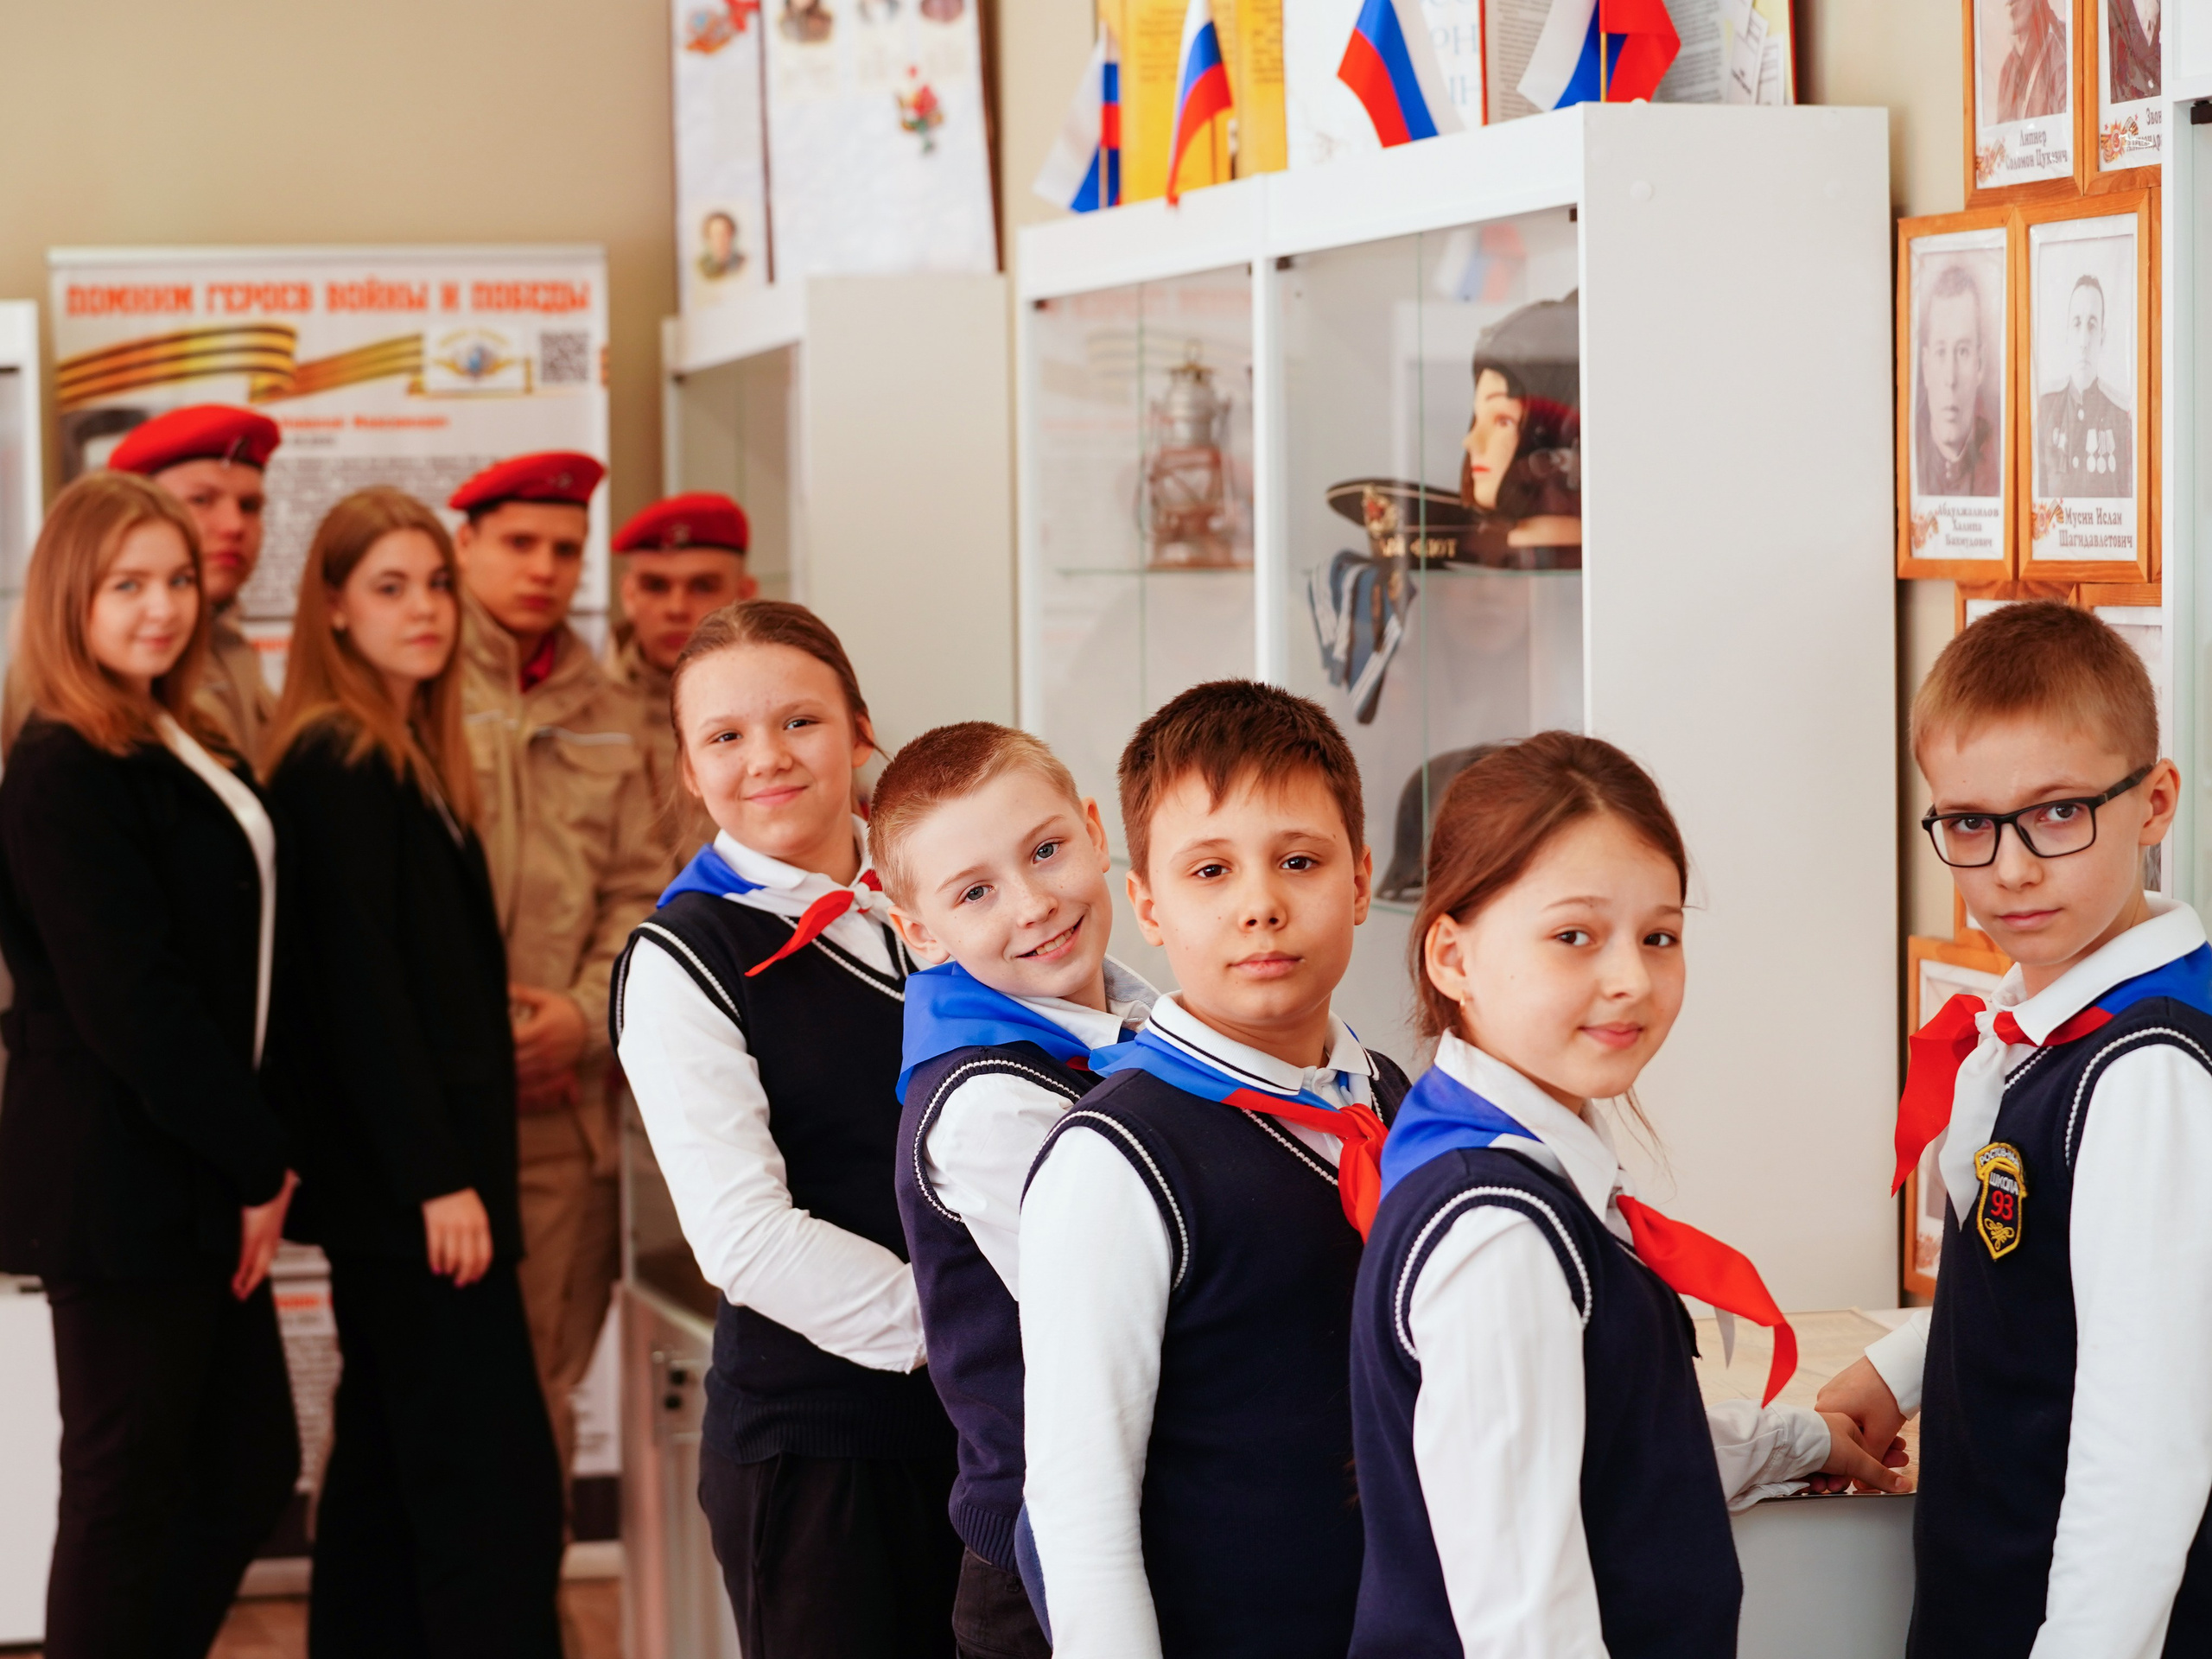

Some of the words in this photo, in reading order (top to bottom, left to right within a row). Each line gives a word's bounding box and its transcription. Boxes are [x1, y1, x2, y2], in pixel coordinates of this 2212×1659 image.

[2019, 130, 2047, 147] Липнер
[2005, 154, 2035, 170] Соломон
[67, 283, 193, 316] ПОМНИМ
[207, 282, 314, 314] ГЕРОЕВ
[327, 275, 428, 313] ВОЙНЫ
[442, 282, 459, 313] И
[472, 279, 590, 315] ПОБЕДЫ
[2064, 507, 2094, 528] Мусин
[2095, 507, 2122, 525] Ислам
[2058, 529, 2133, 549] Шагидавлетович
[1989, 1172, 2018, 1196] ШКОЛА
[1990, 1190, 2013, 1220] 93
